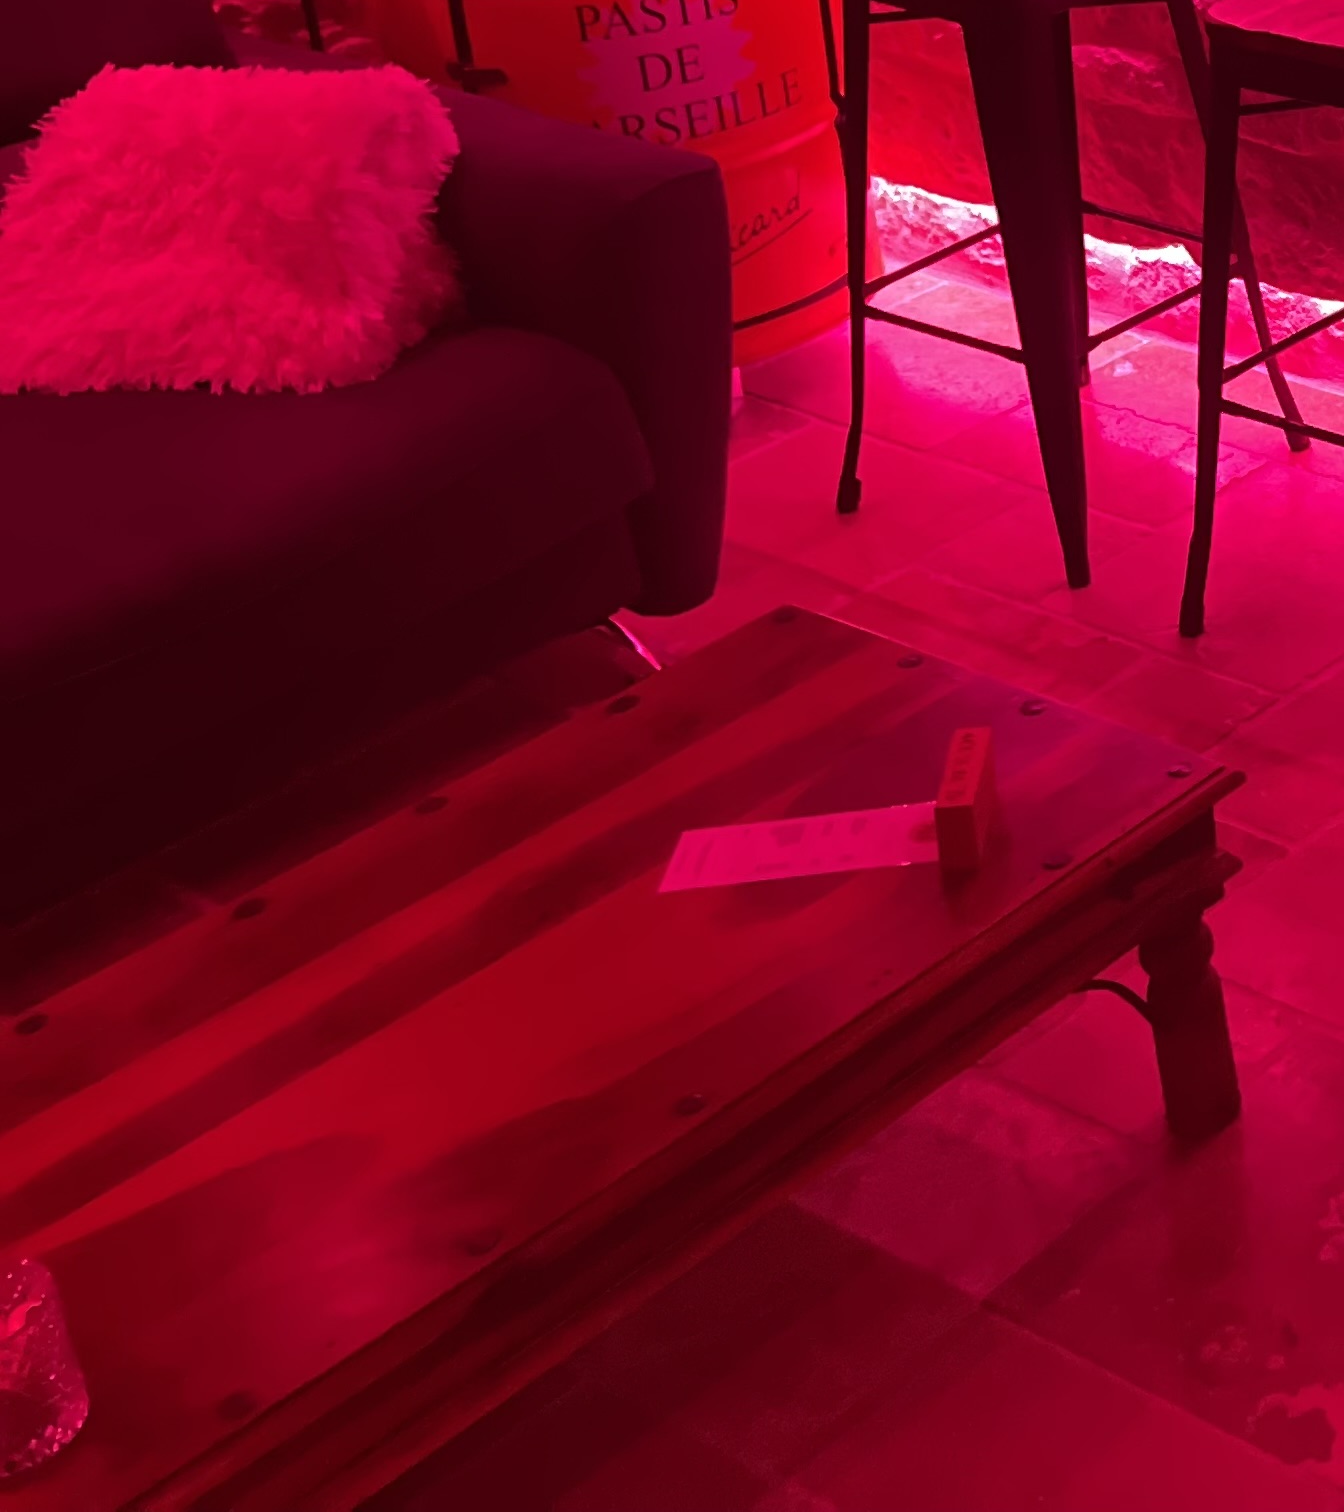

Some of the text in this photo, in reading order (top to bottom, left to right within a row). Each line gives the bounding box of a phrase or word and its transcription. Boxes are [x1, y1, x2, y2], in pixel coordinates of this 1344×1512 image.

[591, 67, 803, 146] RSEILLE
[636, 44, 706, 94] DE
[730, 168, 801, 253] card
